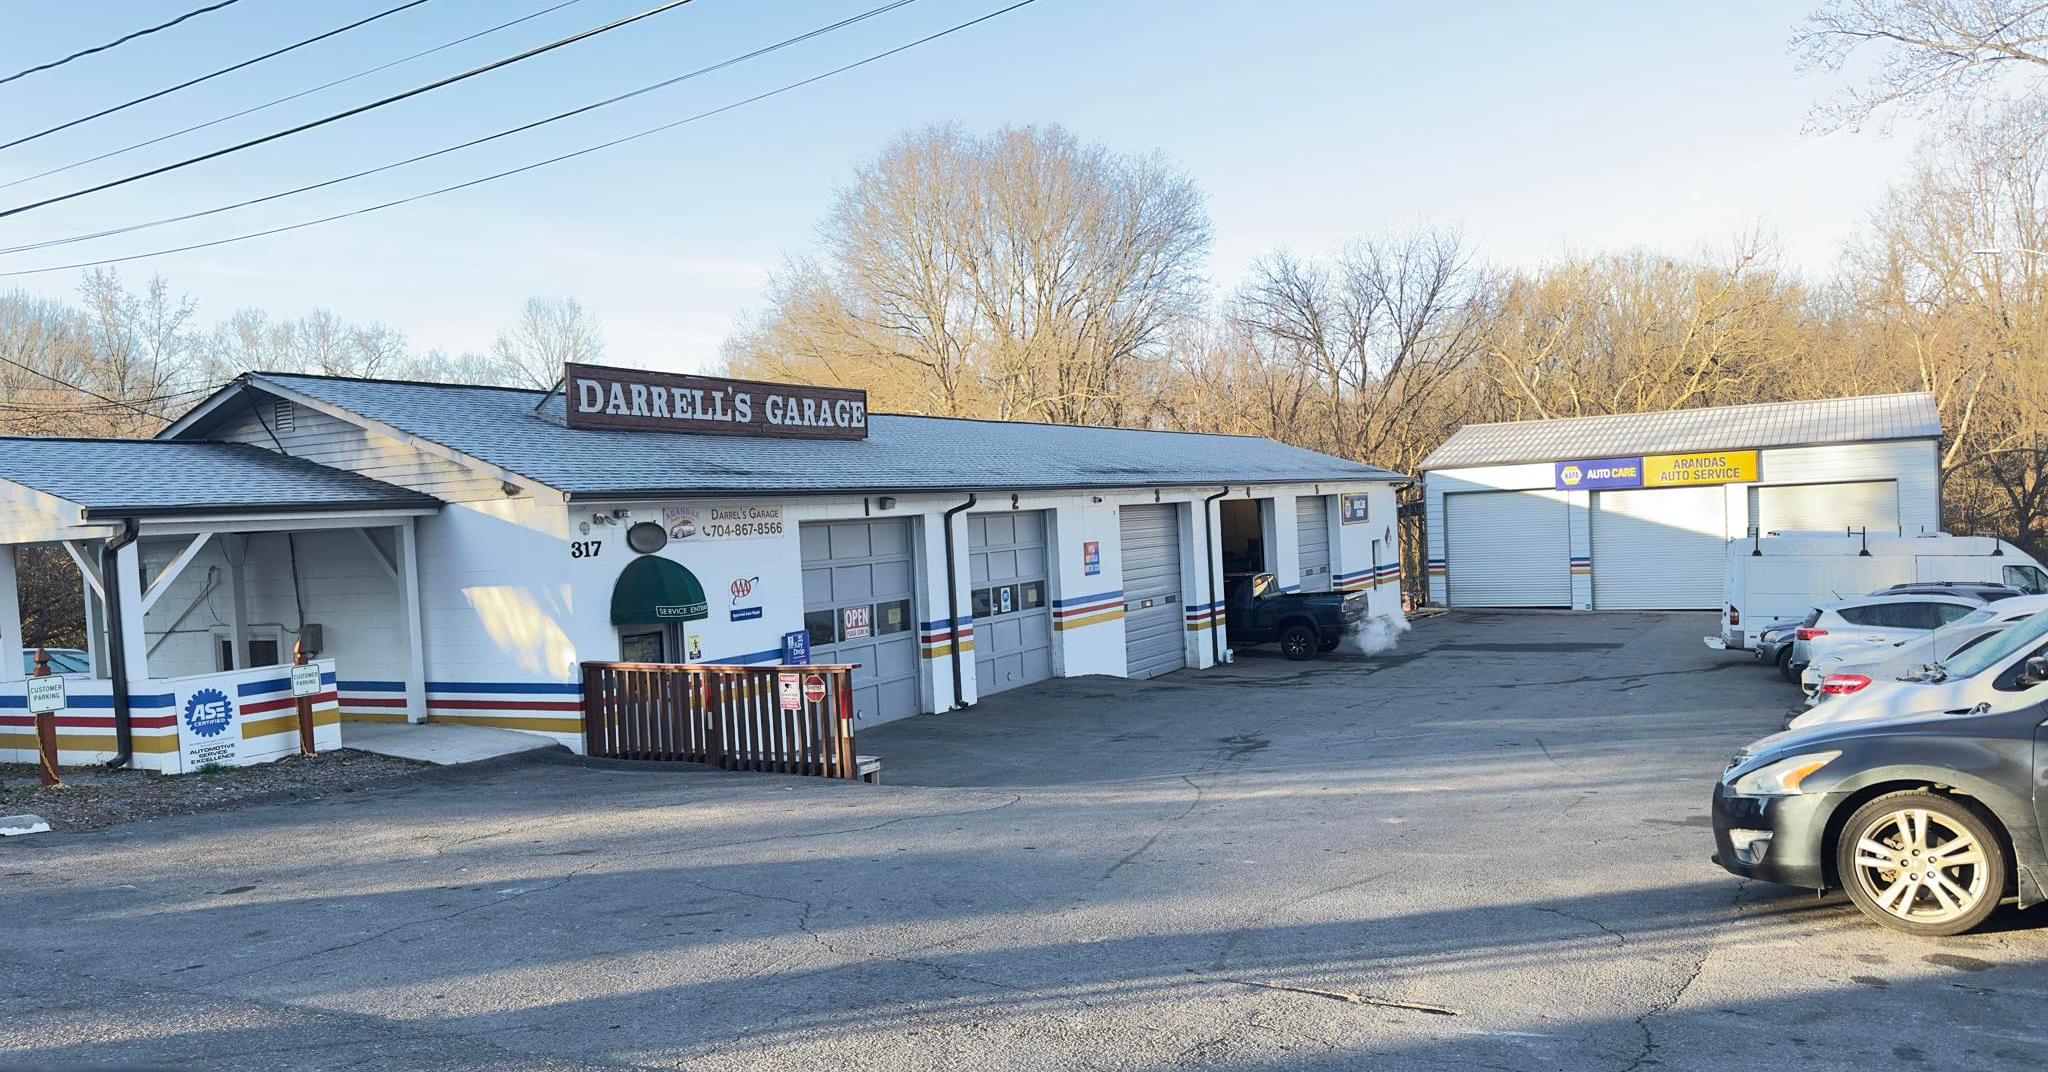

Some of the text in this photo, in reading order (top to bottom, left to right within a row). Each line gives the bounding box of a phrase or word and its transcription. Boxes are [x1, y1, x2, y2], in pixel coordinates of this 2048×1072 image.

[577, 379, 865, 428] DARRELL'S GARAGE
[1673, 457, 1726, 469] ARANDAS
[1564, 472, 1579, 480] NAPA
[1587, 467, 1637, 479] AUTO CARE
[1660, 467, 1740, 481] AUTO SERVICE
[1011, 493, 1019, 510] 2
[749, 507, 779, 519] GARAGE
[711, 522, 783, 537] 704-867-8566
[571, 541, 602, 558] 317
[659, 607, 687, 615] SERVICE
[845, 608, 869, 628] OPEN
[793, 648, 805, 656] Drop
[294, 672, 318, 680] CUSTOMER
[31, 684, 62, 693] CUSTOMER
[34, 692, 60, 700] PARKING
[192, 701, 225, 722] ASE
[190, 743, 236, 755] AUTOMOTIVE
[199, 749, 228, 758] SERVICE
[191, 753, 236, 764] EXCELLENCE
